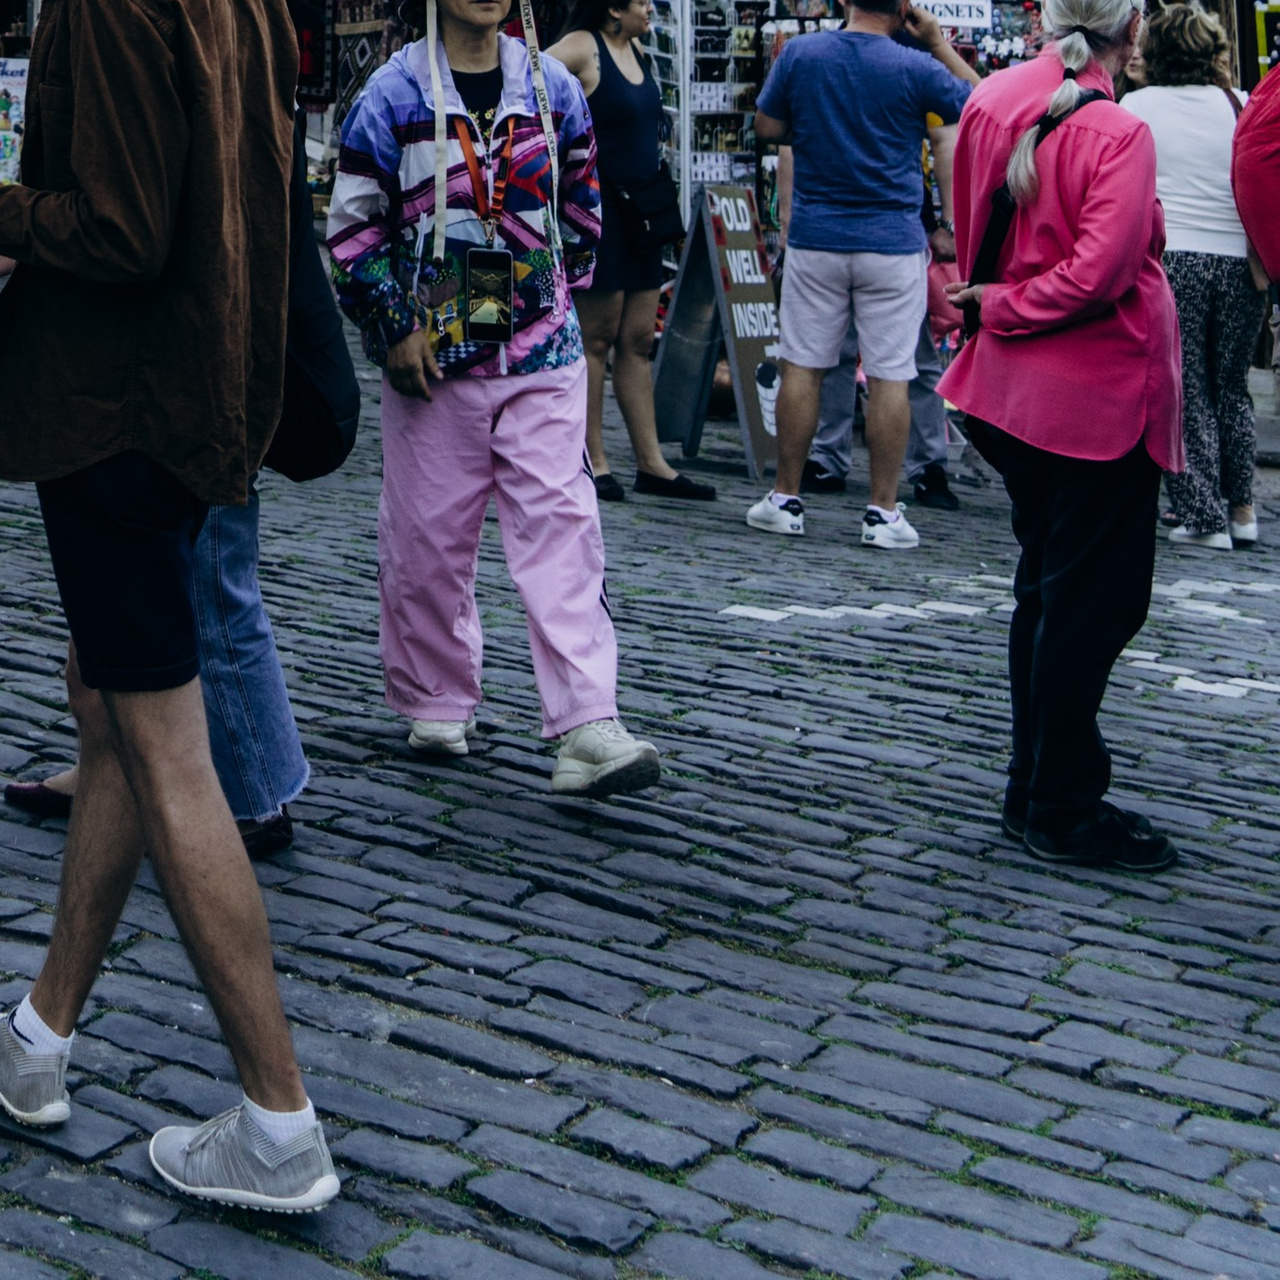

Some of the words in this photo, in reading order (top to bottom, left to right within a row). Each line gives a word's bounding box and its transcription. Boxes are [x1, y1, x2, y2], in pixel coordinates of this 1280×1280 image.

[522, 3, 534, 30] LOEWE
[916, 2, 985, 19] AGNETS
[529, 45, 540, 72] LOEWE
[538, 88, 550, 116] LOEWE
[721, 196, 751, 232] OLD
[725, 248, 766, 284] WELL
[731, 301, 780, 339] INSIDE
